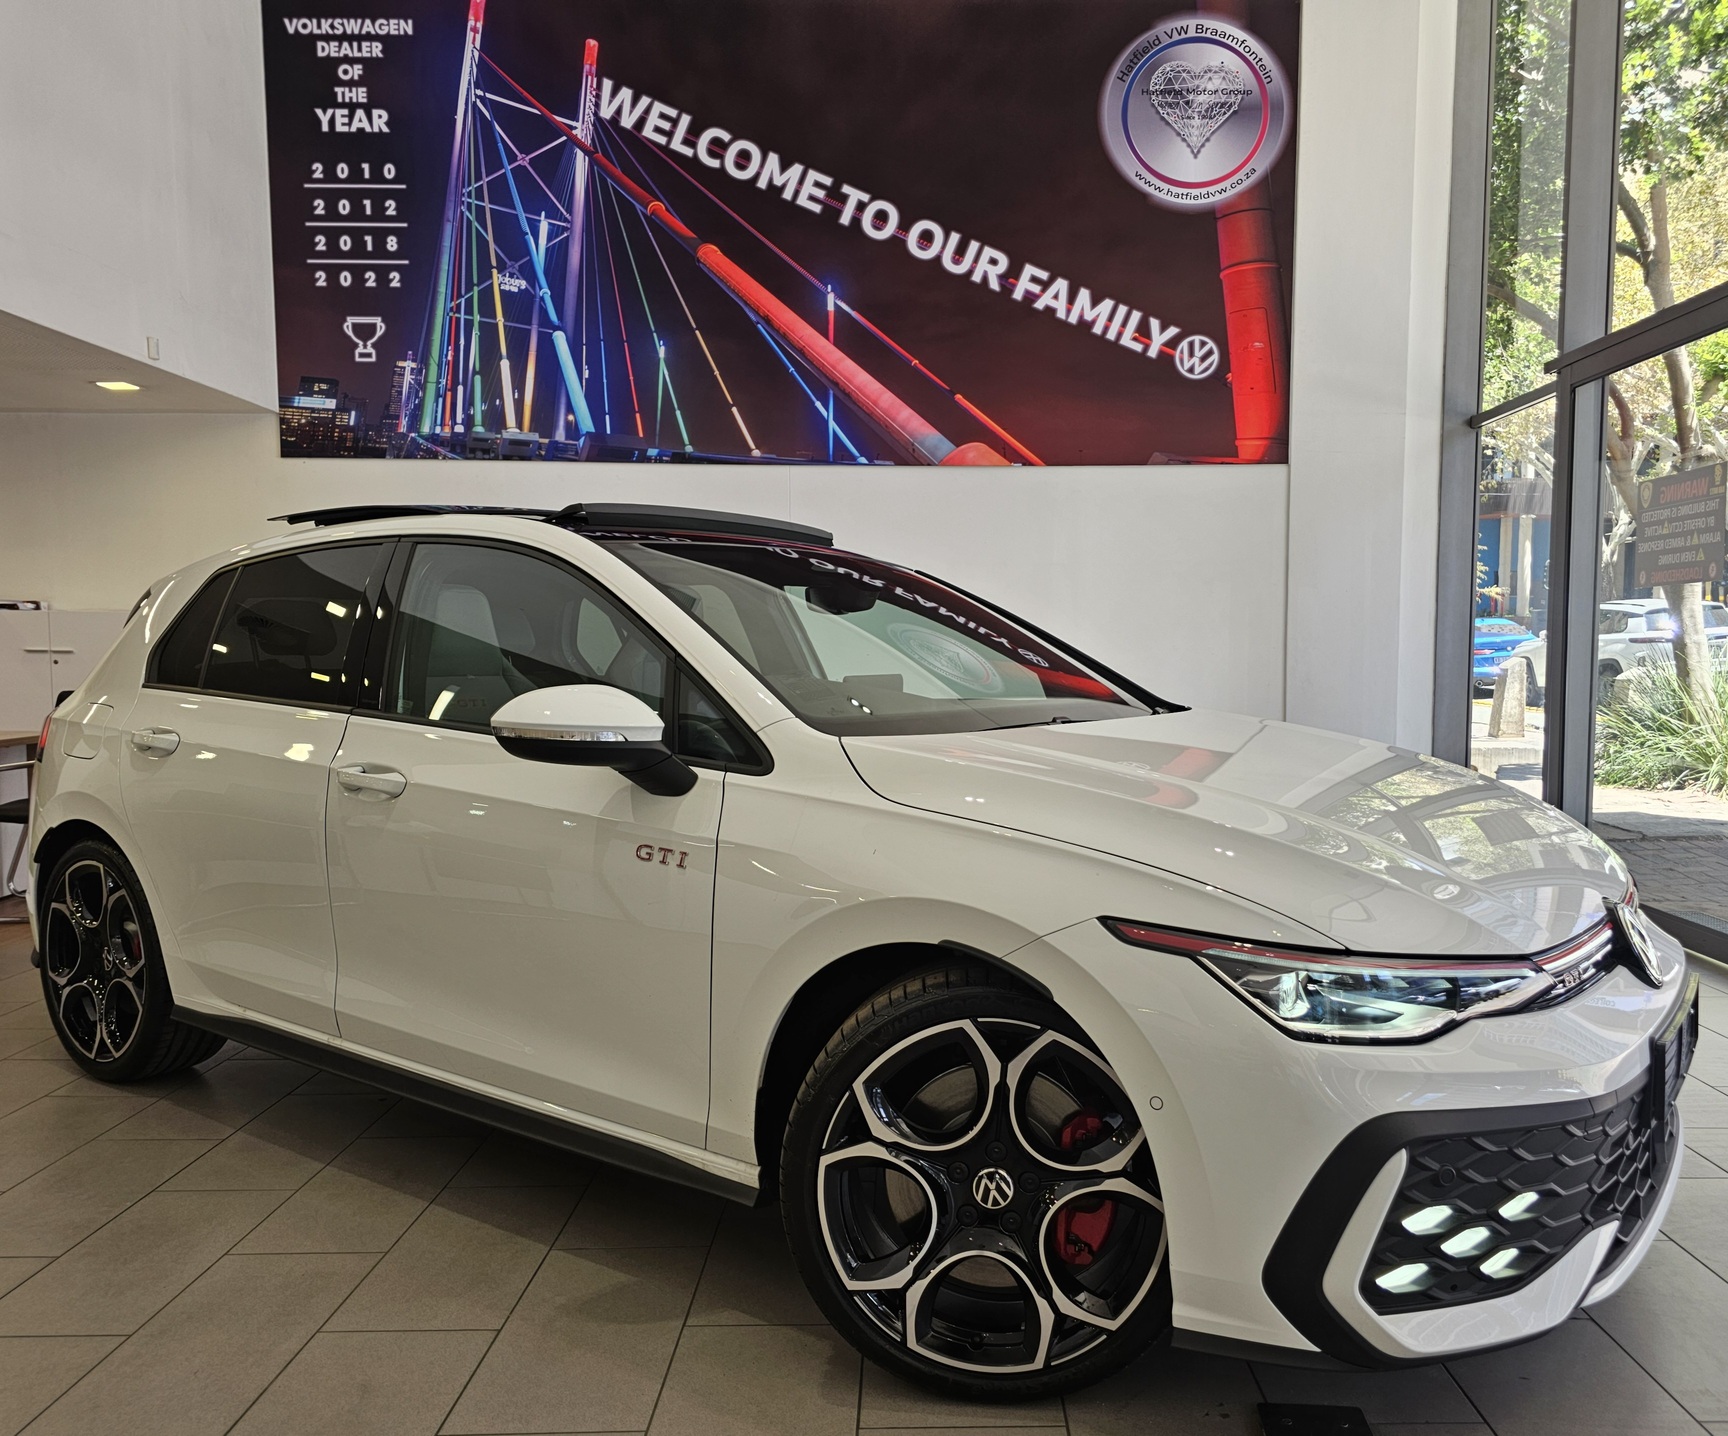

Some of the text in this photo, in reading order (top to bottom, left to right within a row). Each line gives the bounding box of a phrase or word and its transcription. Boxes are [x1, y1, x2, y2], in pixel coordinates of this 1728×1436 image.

[284, 18, 413, 35] VOLKSWAGEN
[316, 41, 383, 57] DEALER
[1117, 23, 1273, 85] Hatfield VW Braamfontein
[337, 64, 363, 80] OF
[334, 87, 368, 102] THE
[1141, 88, 1253, 97] Hatfield Motor Group
[314, 108, 390, 132] YEAR
[311, 163, 396, 179] 2010
[1134, 167, 1257, 201] www.hatfieldvw.co.za
[313, 199, 397, 215] 2012
[600, 77, 833, 214] WELCOME
[838, 184, 899, 240] TO
[907, 219, 1009, 292] OUR
[1012, 263, 1181, 359] FAMILY
[314, 235, 398, 251] 2018
[315, 271, 401, 287] 2022
[636, 844, 689, 870] GTI
